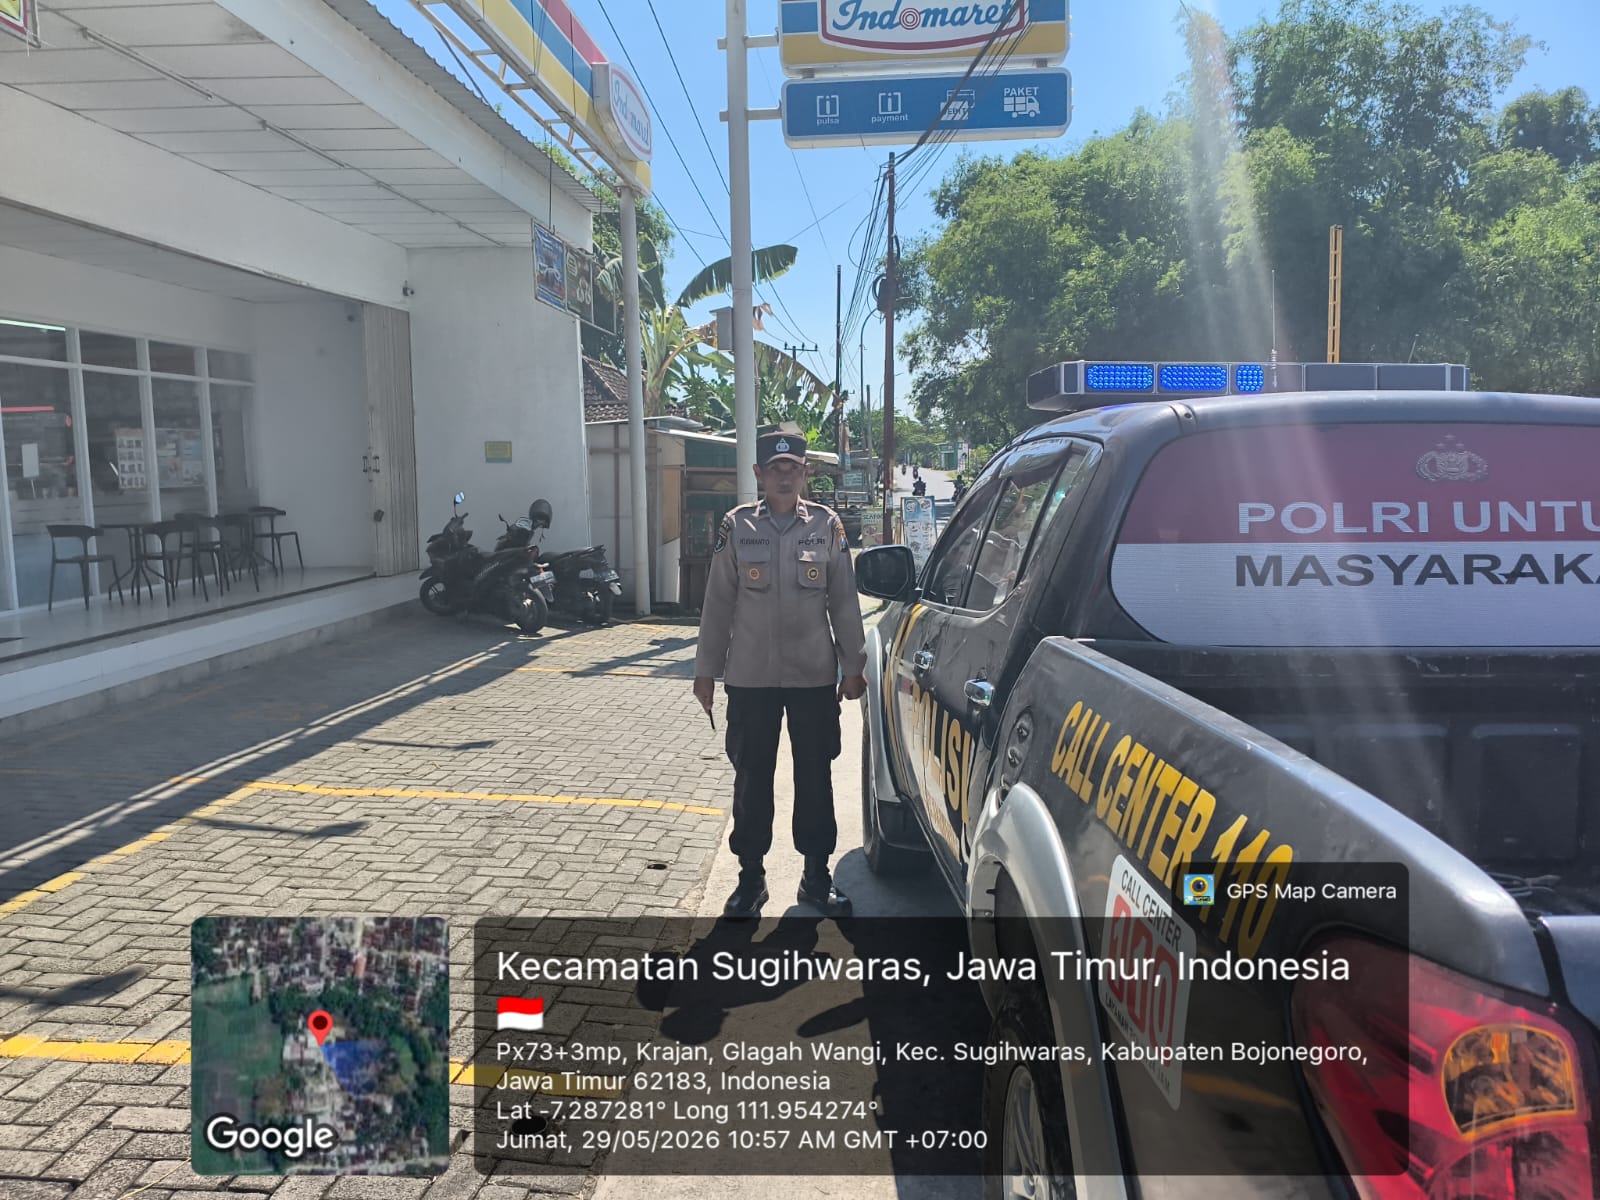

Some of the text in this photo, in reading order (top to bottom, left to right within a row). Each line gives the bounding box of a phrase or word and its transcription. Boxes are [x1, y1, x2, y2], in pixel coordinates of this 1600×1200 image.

[832, 0, 1016, 31] Indomaret
[1003, 86, 1039, 97] PAKET
[816, 116, 840, 126] pulsa
[871, 113, 909, 125] payment
[1238, 501, 1428, 534] POLRI
[798, 538, 826, 546] POLRI
[911, 680, 974, 825] POLISI
[1050, 700, 1111, 803] CALL
[1096, 734, 1217, 902] CENTER
[1199, 813, 1294, 960] 110
[1120, 869, 1182, 952] CALL CENTER
